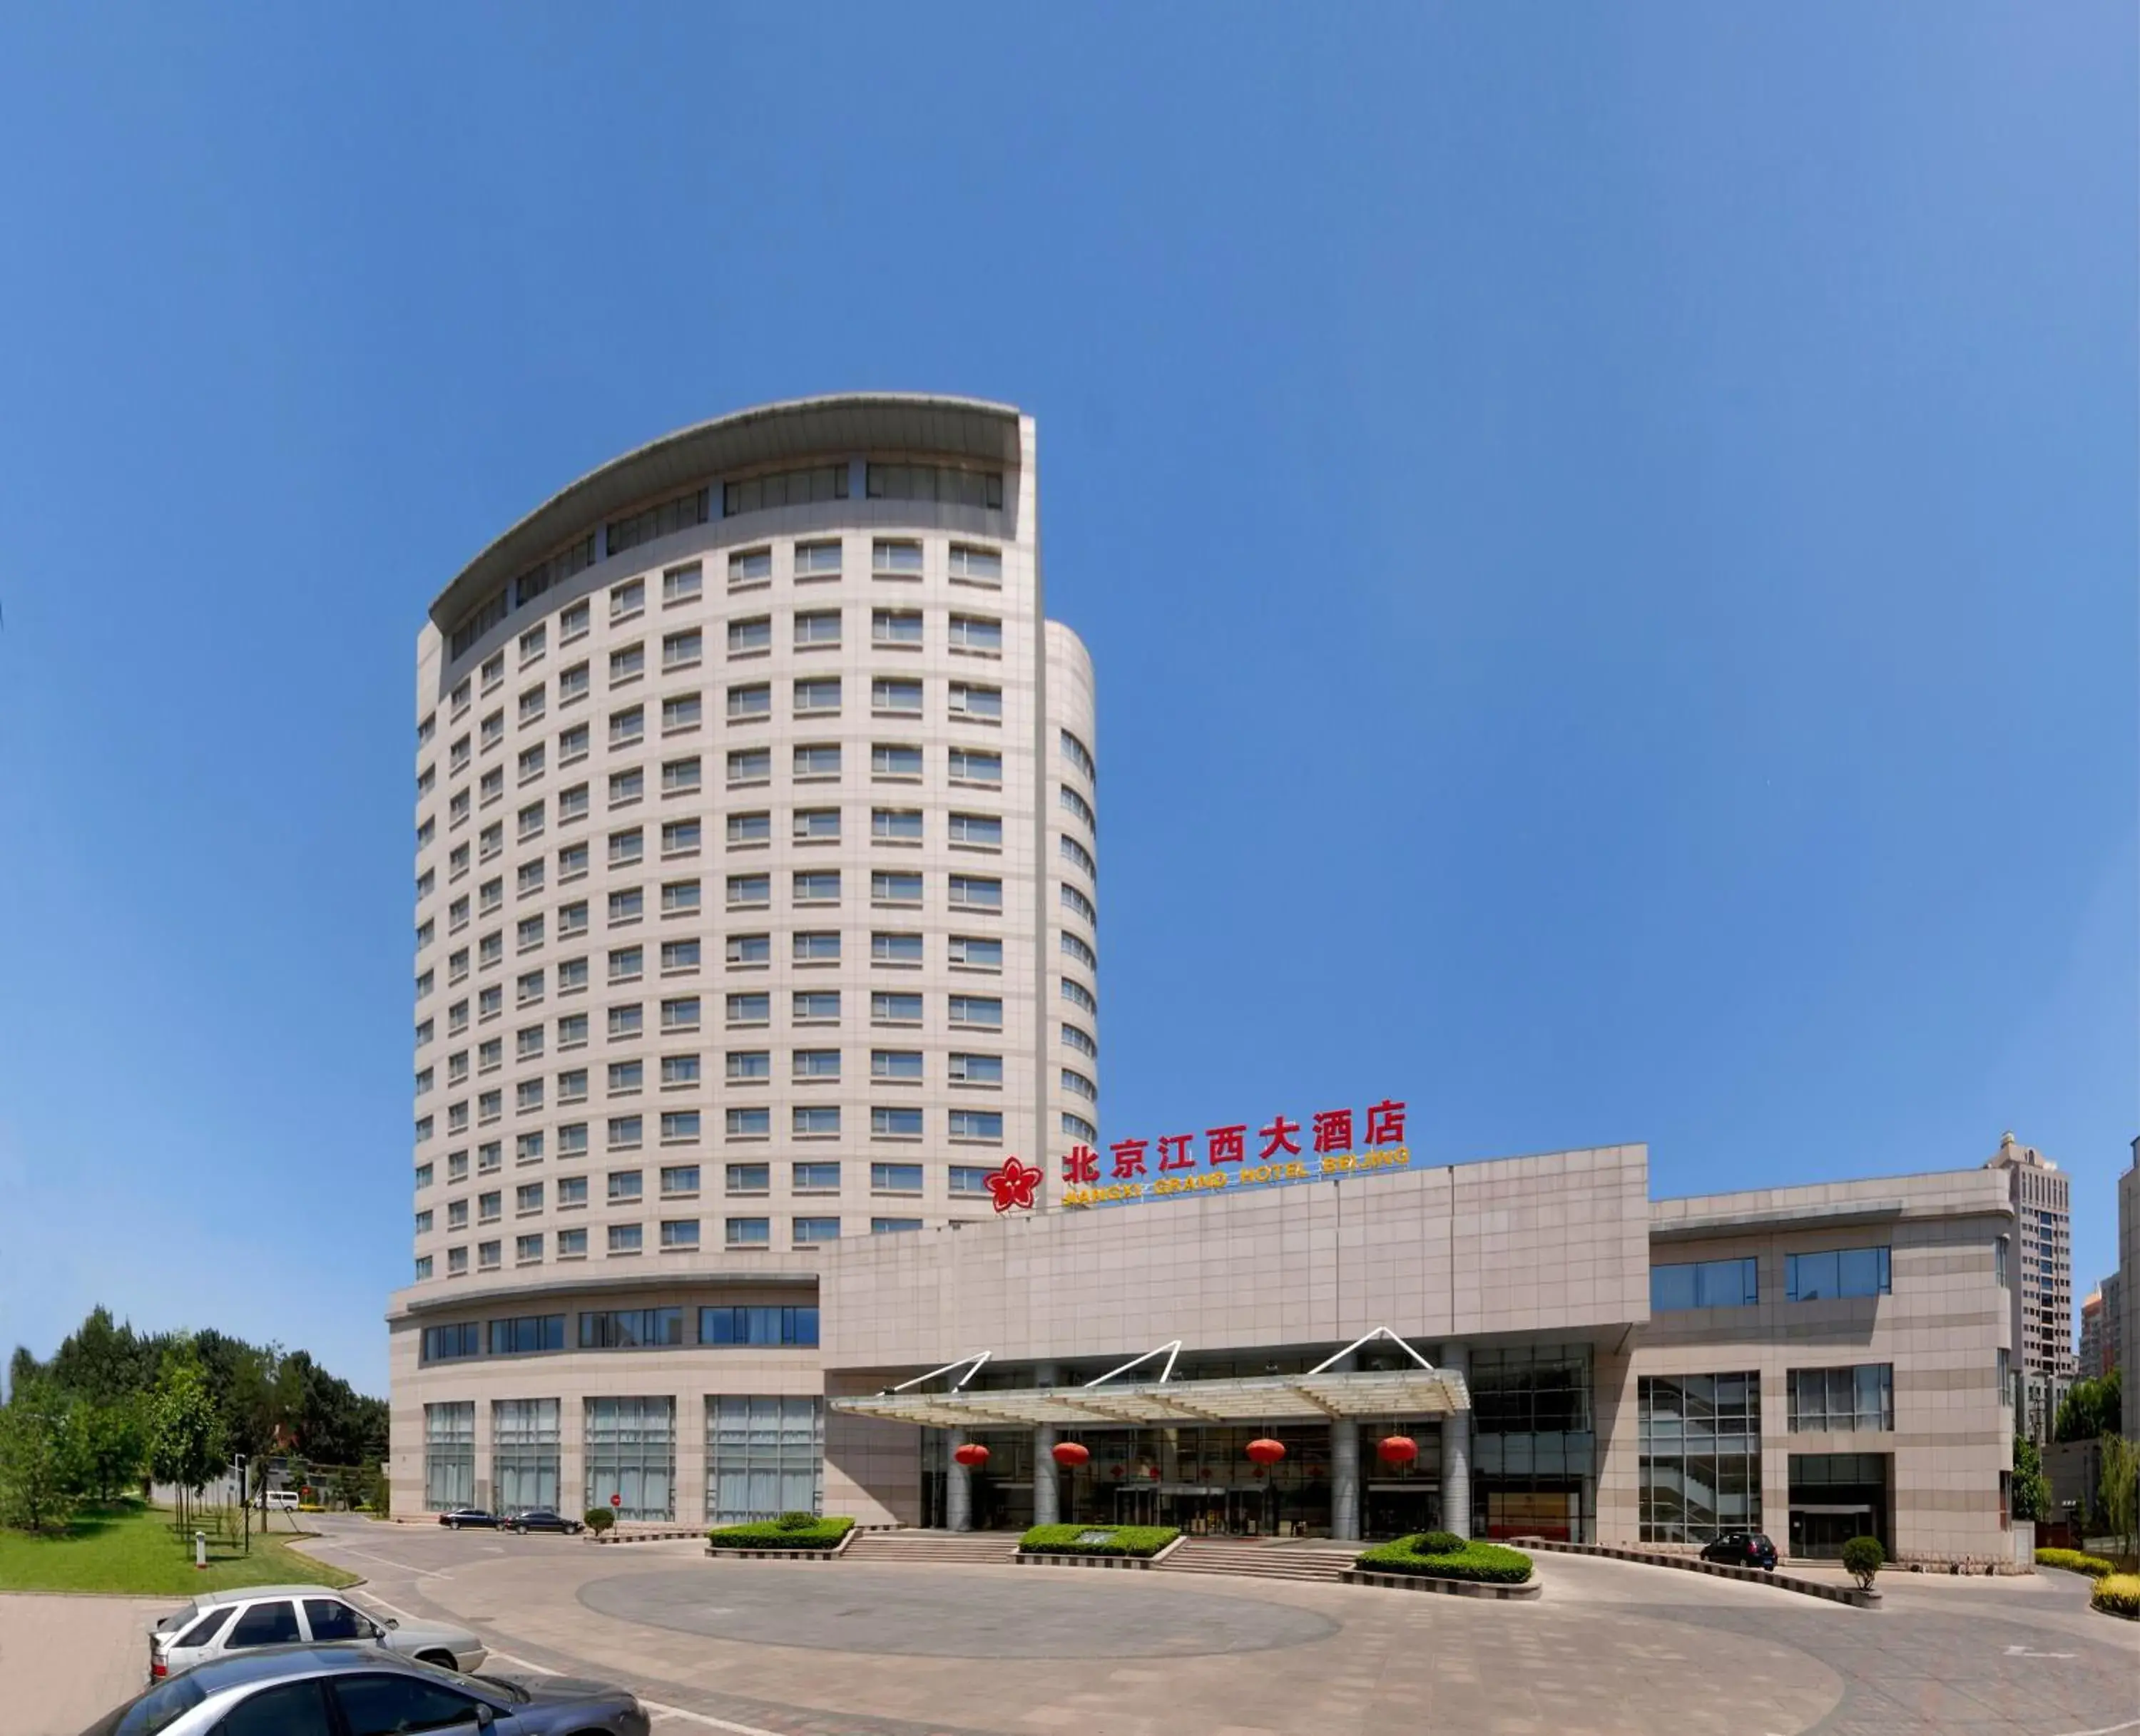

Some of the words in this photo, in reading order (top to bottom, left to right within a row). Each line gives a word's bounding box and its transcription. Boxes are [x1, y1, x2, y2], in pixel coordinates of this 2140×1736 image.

[1061, 1100, 1406, 1184] 北京江西大酒店
[1153, 1171, 1228, 1195] GRAND
[1240, 1162, 1309, 1184] HOTEL
[1322, 1146, 1410, 1173] BEIJING
